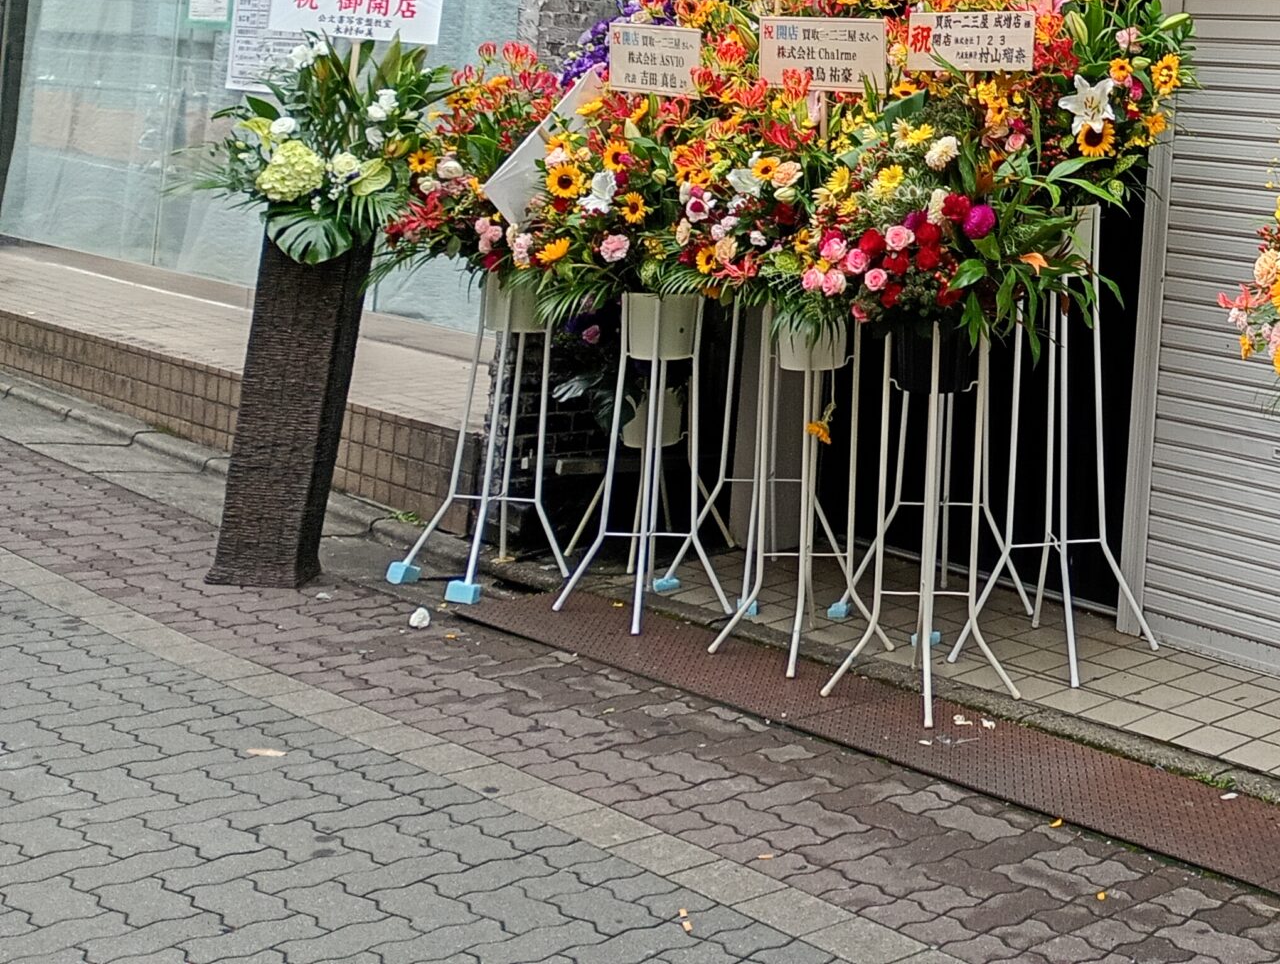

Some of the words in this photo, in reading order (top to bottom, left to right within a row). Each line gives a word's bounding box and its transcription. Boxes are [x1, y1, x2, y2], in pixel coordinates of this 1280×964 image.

[777, 45, 816, 60] 株式会社
[659, 55, 685, 68] ASVIO
